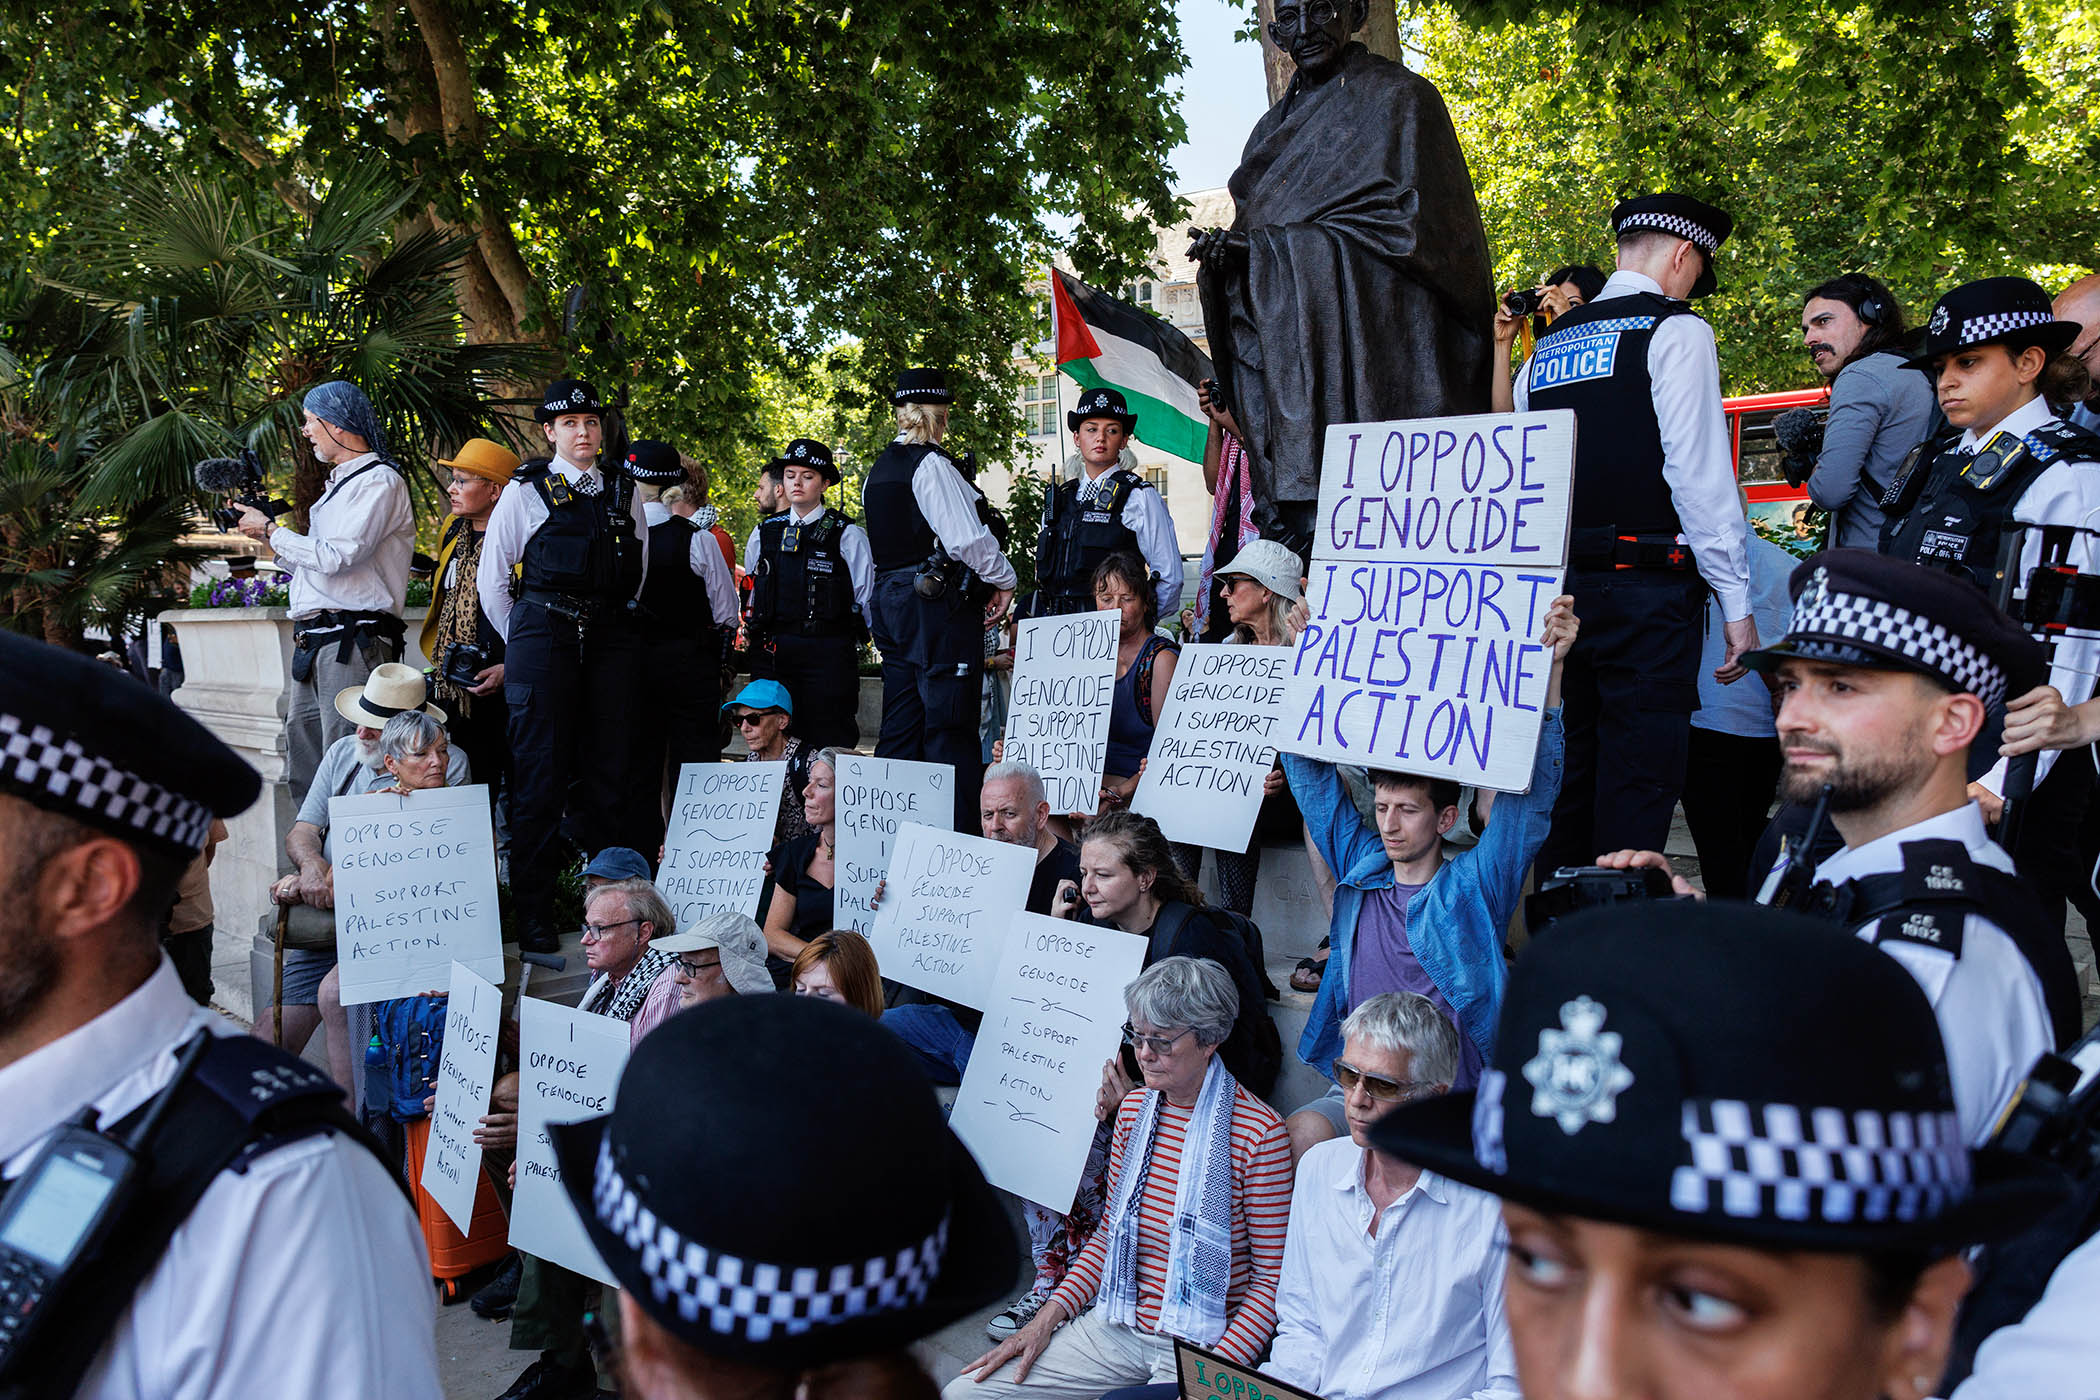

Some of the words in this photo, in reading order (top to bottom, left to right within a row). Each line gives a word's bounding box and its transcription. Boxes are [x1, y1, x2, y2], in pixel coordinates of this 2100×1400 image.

[1537, 336, 1614, 361] METROPOLITAN
[1533, 348, 1611, 387] POLICE
[1341, 433, 1362, 489] I
[1379, 423, 1548, 494] OPPOSE
[1330, 495, 1544, 554] GENOCIDE
[1317, 565, 1338, 621] I
[1341, 567, 1557, 639] SUPPORT
[1025, 627, 1039, 662] I
[1053, 618, 1119, 662] OPPOSE
[1188, 653, 1198, 677] I
[1203, 653, 1287, 681] OPPOSE
[1293, 624, 1543, 712] PALESTINE
[1013, 674, 1113, 707] GENOCIDE
[1175, 683, 1286, 705] GENOCIDE
[1008, 714, 1022, 740] I
[1028, 710, 1101, 741] SUPPORT
[1174, 711, 1182, 729] I
[1188, 711, 1279, 737] SUPPORT
[1297, 684, 1494, 771] ACTION
[1005, 741, 1105, 774] PALESTINE
[1158, 737, 1276, 767] PALESTINE
[685, 774, 697, 795] I
[703, 774, 773, 794] OPPOSE
[886, 762, 889, 780] I
[1159, 763, 1252, 797] ACTION
[842, 785, 919, 812] OPPOSE
[1042, 776, 1097, 812] TION
[682, 801, 769, 825] GENOCIDE
[345, 818, 452, 843] OPPOSE
[341, 842, 470, 869] GENOCIDE
[668, 848, 681, 868] I
[688, 850, 765, 869] SUPPORT
[881, 841, 884, 857] I
[904, 840, 916, 880] I
[927, 844, 995, 877] OPPOSE
[846, 862, 888, 883] SUPP
[912, 875, 974, 898] GENOCIDE
[350, 893, 355, 908] I
[376, 881, 466, 903] SUPPORT
[665, 877, 757, 897] PALESTINE
[345, 901, 479, 933] PALESTINE
[893, 902, 901, 924] I
[916, 905, 983, 928] SUPPORT
[898, 928, 973, 954] PALESTINE
[1025, 931, 1030, 948] I
[1037, 934, 1096, 959] OPPOSE
[912, 953, 964, 975] ACTION
[1019, 965, 1089, 993] GENOCIDE
[472, 986, 477, 1013] I
[451, 1010, 492, 1054] OPPOSE
[570, 1022, 573, 1042] I
[1004, 1016, 1008, 1027] I
[1021, 1022, 1079, 1047] SUPPORT
[530, 1052, 587, 1078] OPPOSE
[1001, 1043, 1066, 1074] PALESTINE
[537, 1081, 607, 1111] GENOCIDE
[1000, 1073, 1053, 1101] ACTION
[525, 1160, 562, 1183] PALEST
[1195, 1360, 1211, 1387] I
[1215, 1372, 1278, 1400] OPP
